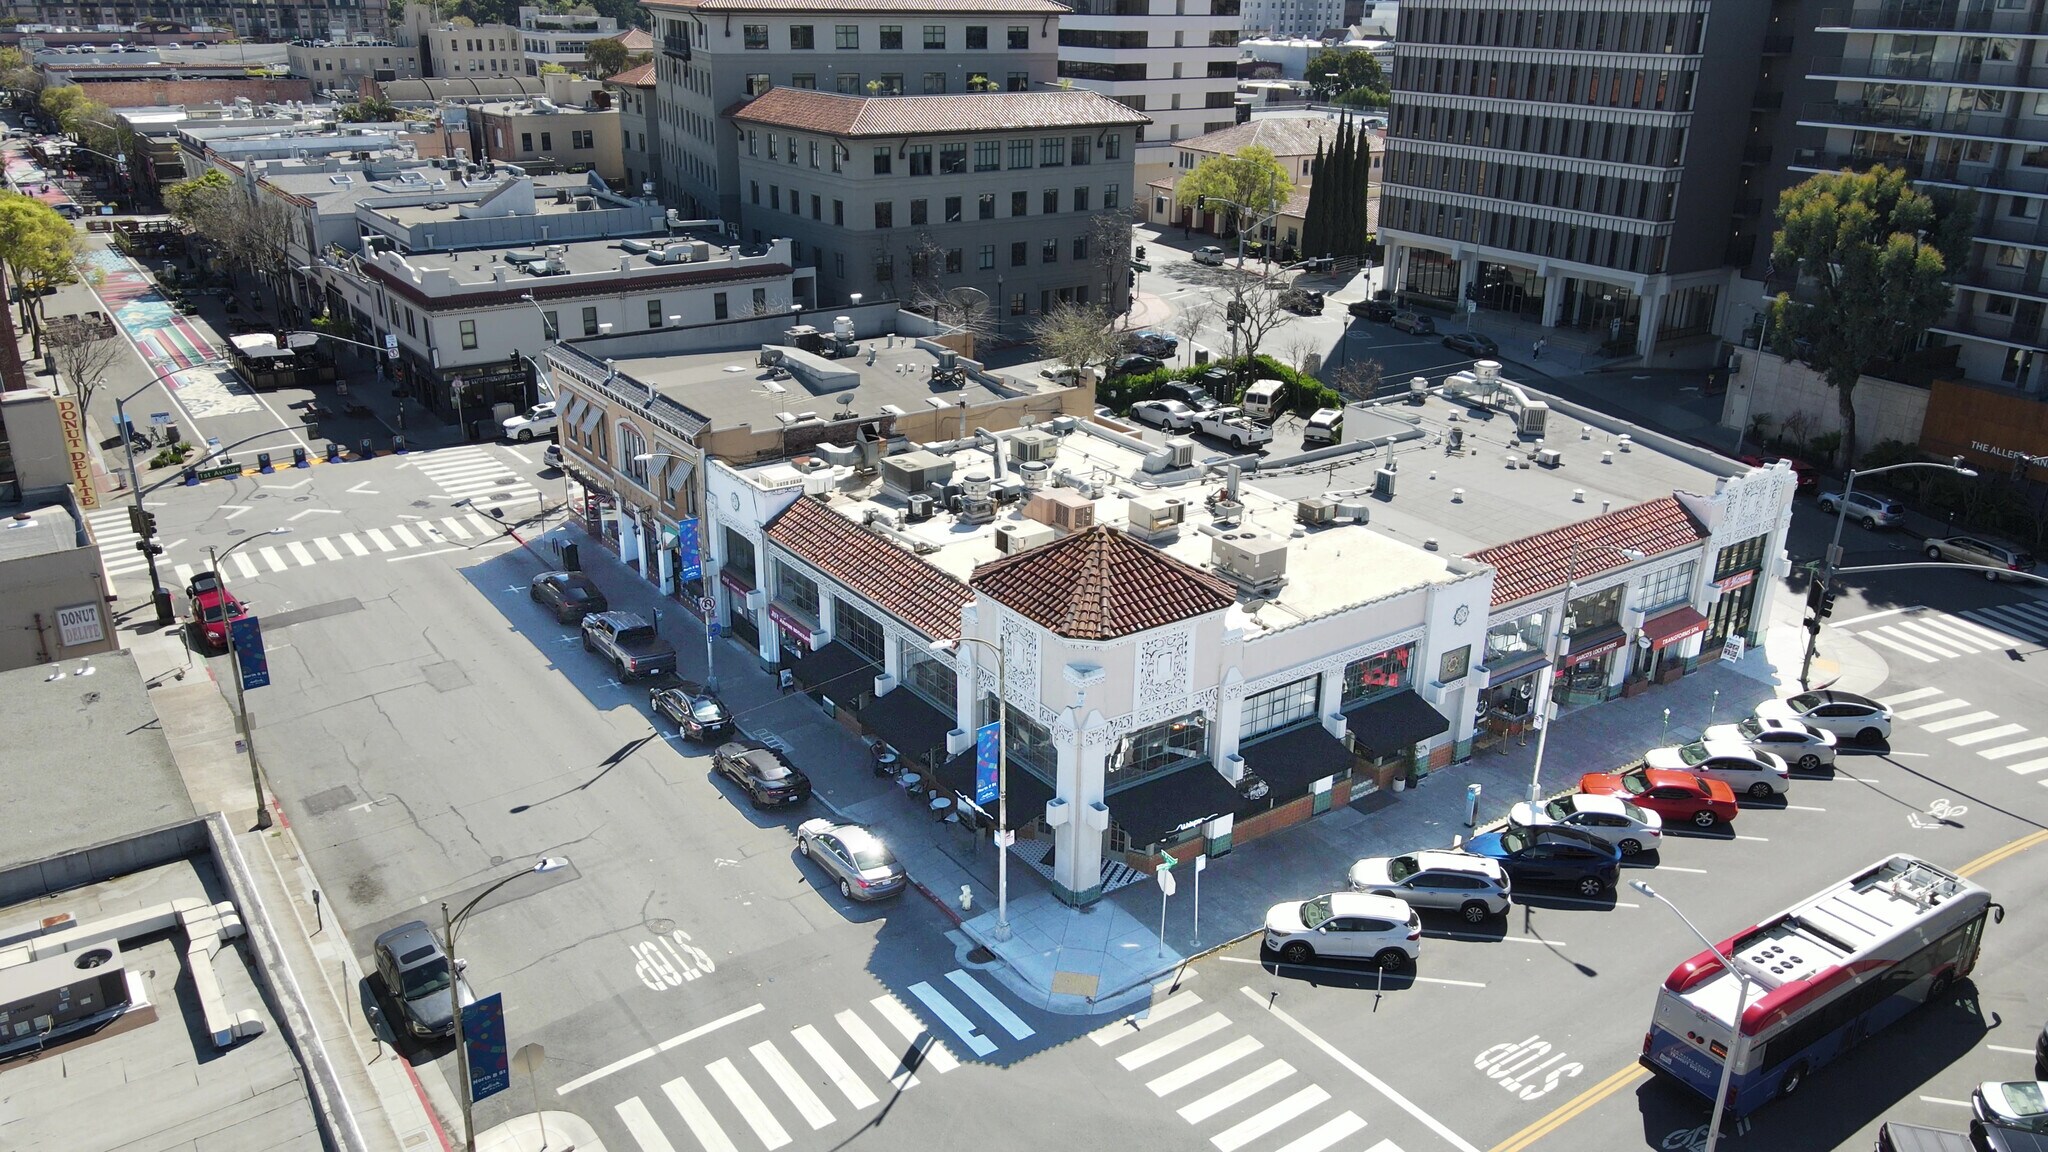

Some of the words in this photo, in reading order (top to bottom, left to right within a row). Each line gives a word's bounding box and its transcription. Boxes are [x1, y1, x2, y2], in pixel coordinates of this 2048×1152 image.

[59, 401, 82, 448] DONUT
[71, 451, 95, 506] DELITE
[1971, 440, 1989, 452] THE
[214, 467, 240, 476] Avenue
[61, 607, 96, 626] DONUT
[65, 624, 101, 642] DELITE
[630, 929, 715, 991] STOP
[1474, 1035, 1584, 1100] STOP
